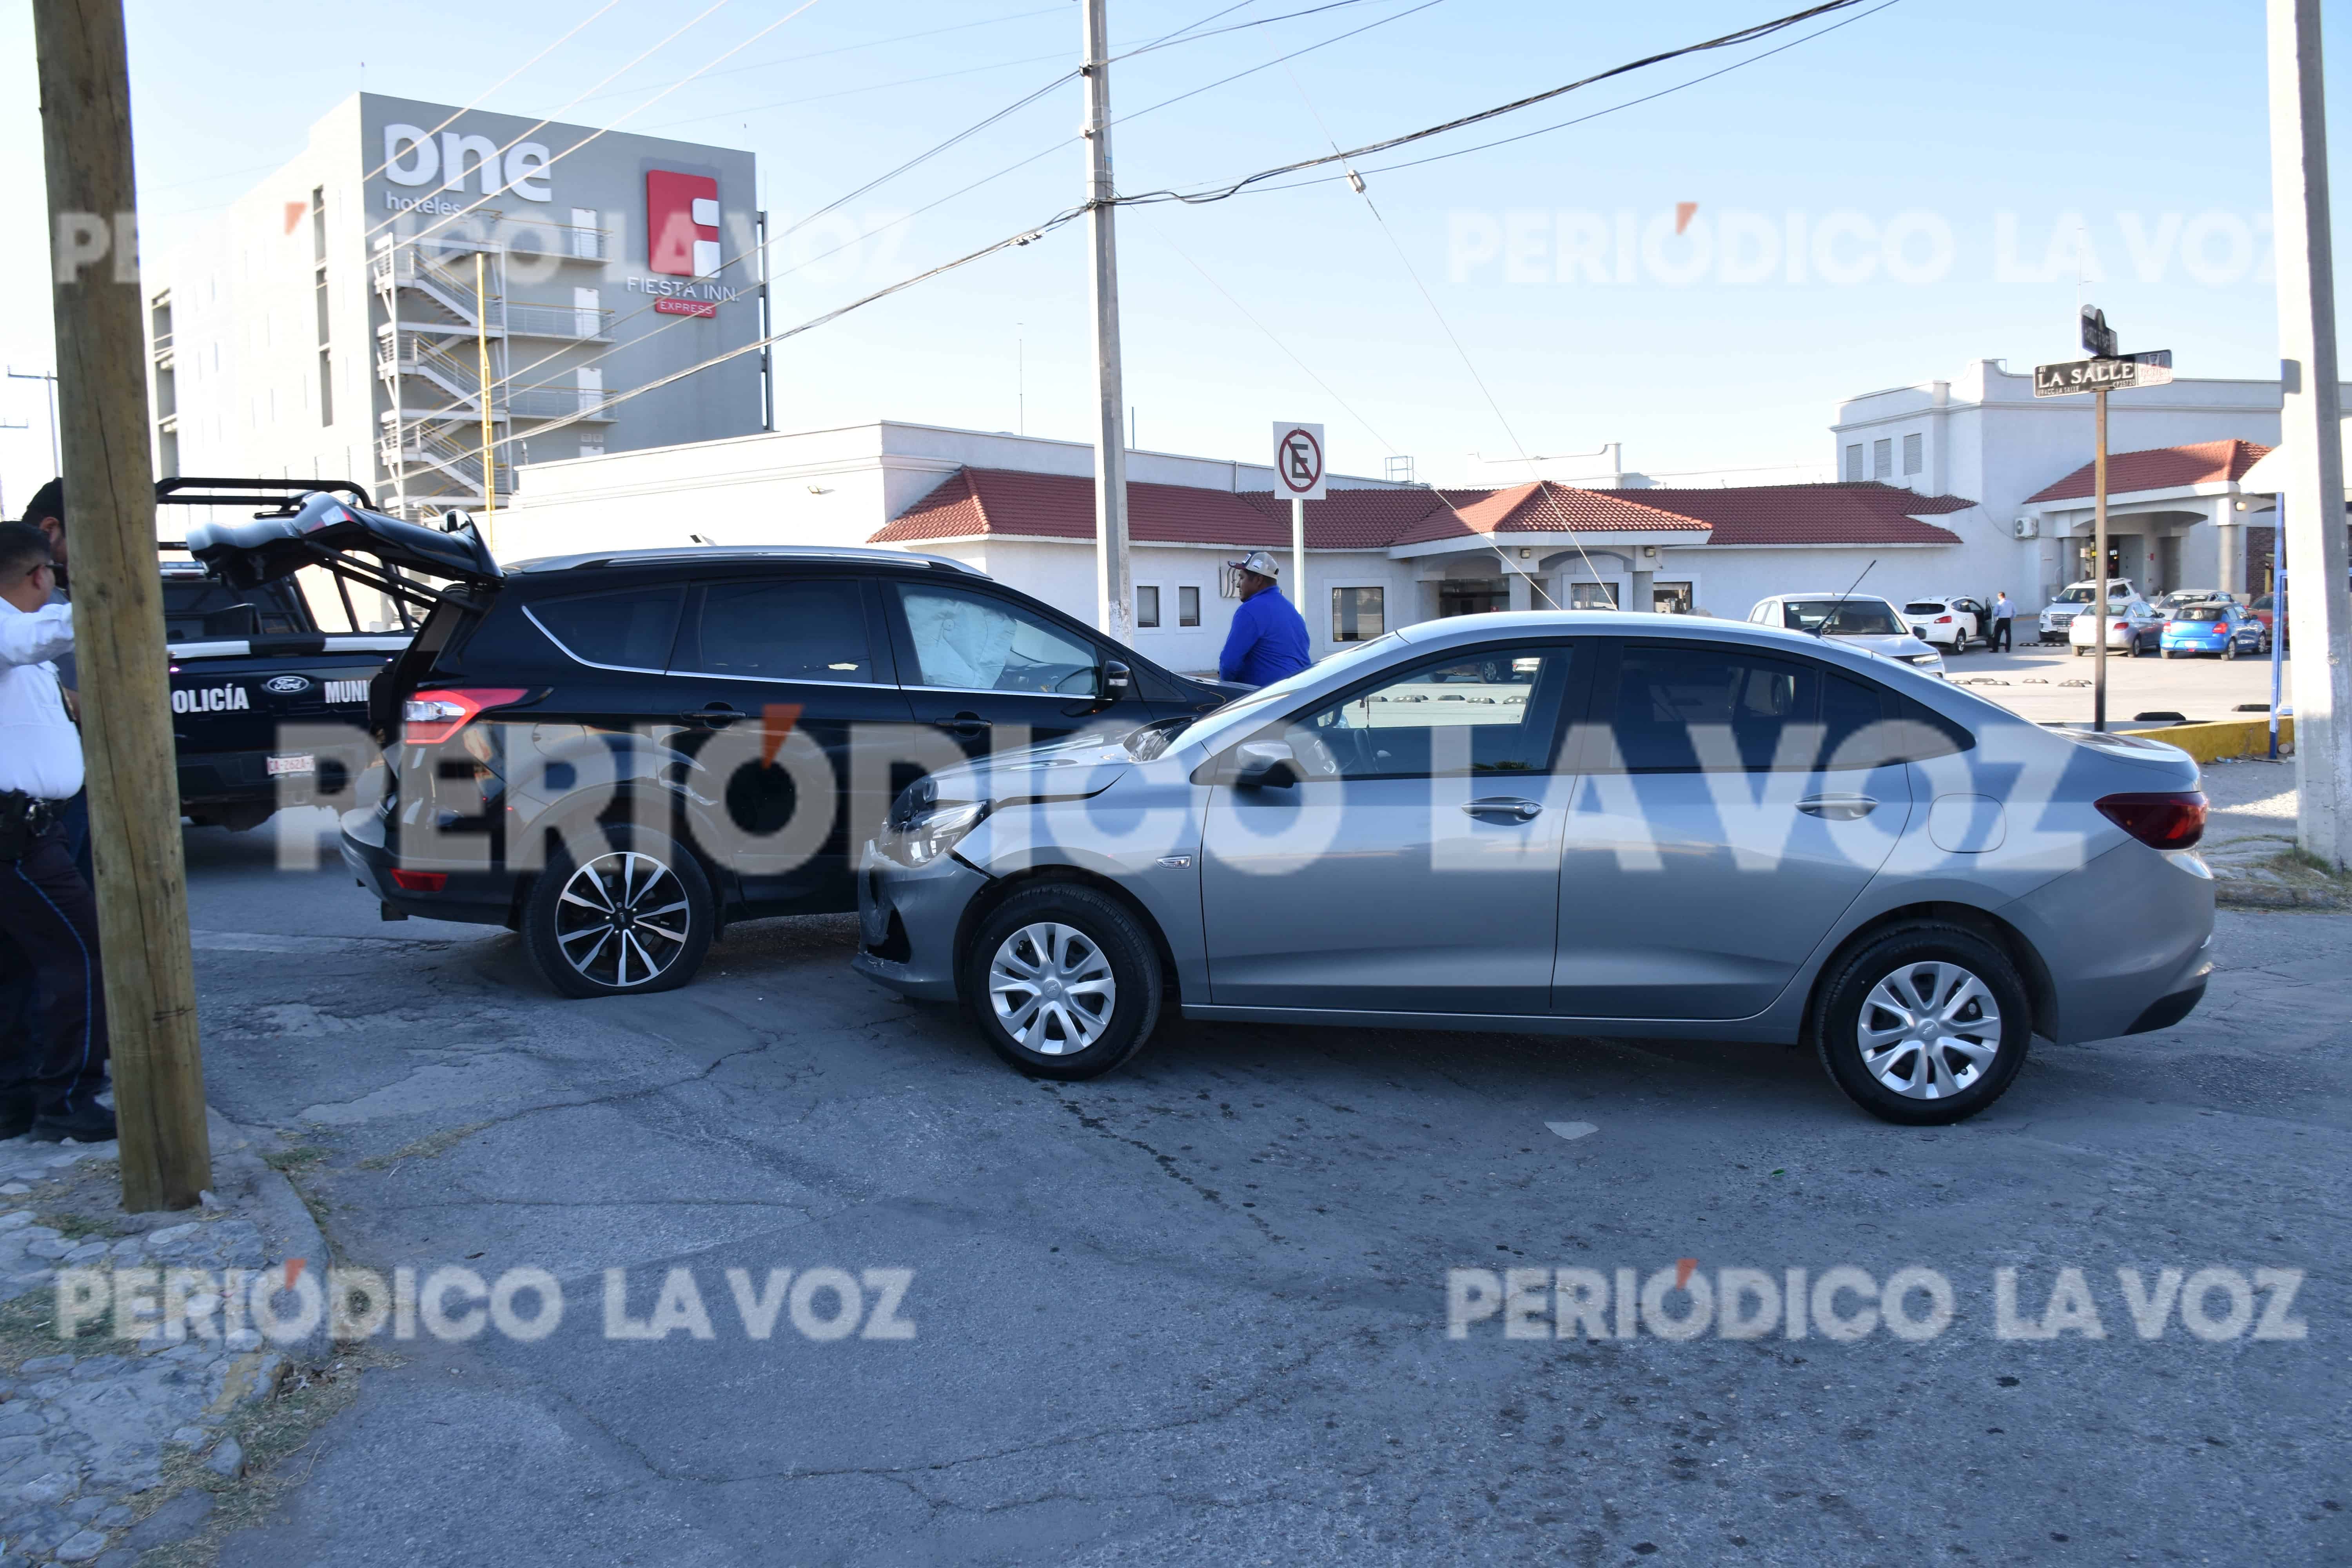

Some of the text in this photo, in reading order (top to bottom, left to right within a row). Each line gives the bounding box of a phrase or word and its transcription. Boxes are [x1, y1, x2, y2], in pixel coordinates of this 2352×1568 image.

[386, 191, 462, 216] hoteles
[626, 276, 697, 298] FIESTA
[660, 301, 713, 314] EXPRESS
[2037, 363, 2134, 388] LA SALLE
[2064, 385, 2079, 394] SALLE
[1292, 443, 1310, 479] E
[172, 683, 250, 713] OLICÍA
[325, 680, 371, 703] MUNI
